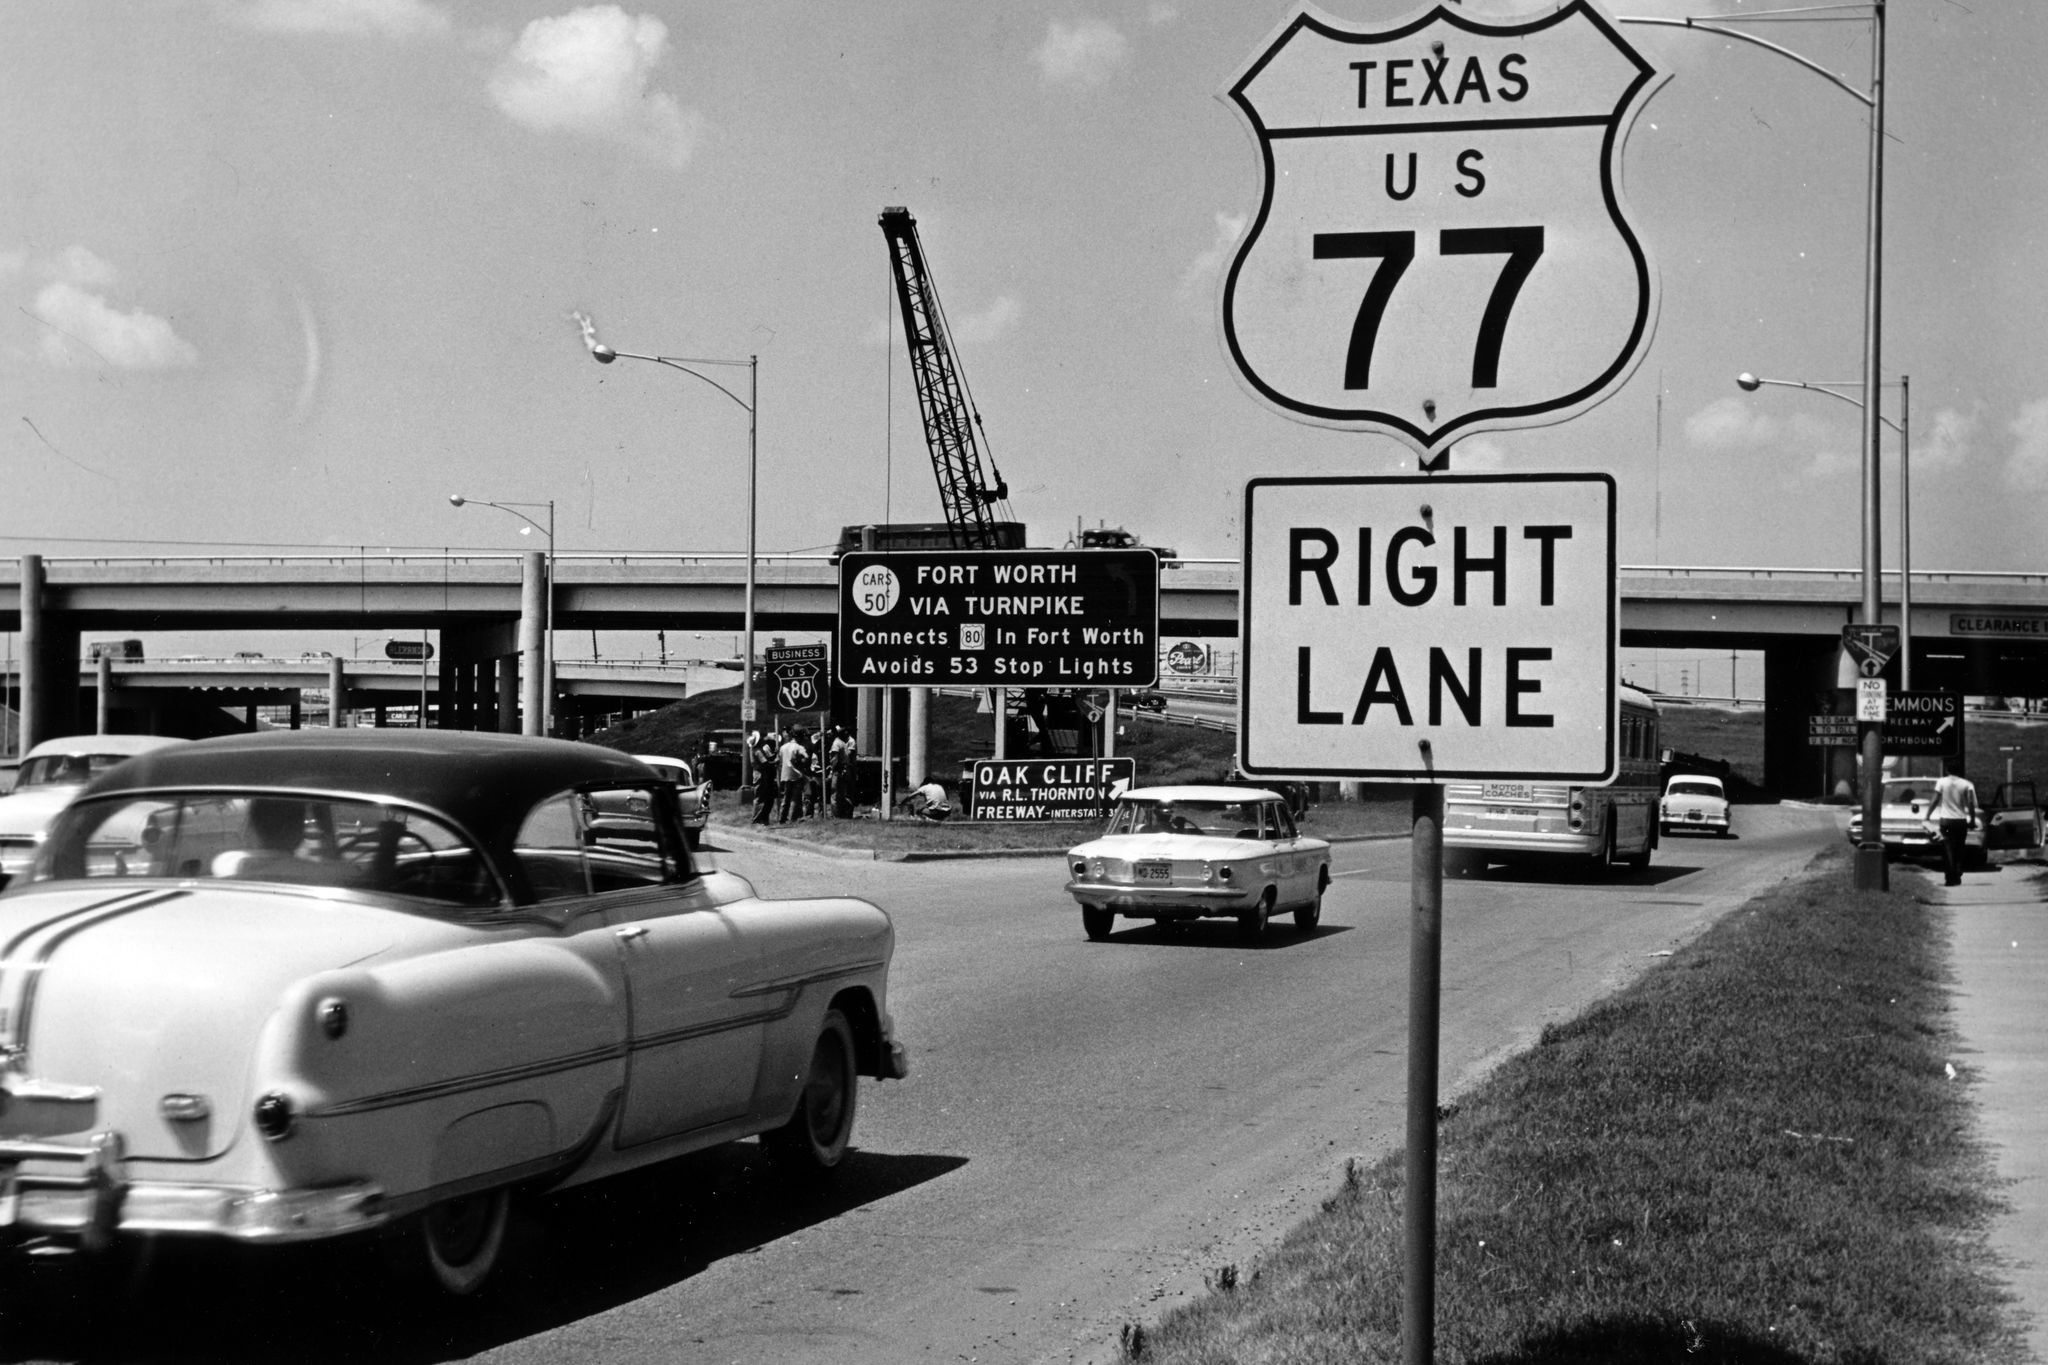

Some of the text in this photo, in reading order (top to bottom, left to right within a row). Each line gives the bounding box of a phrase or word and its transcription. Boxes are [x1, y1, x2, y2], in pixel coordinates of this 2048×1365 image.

[1349, 53, 1529, 108] TEXAS
[1313, 225, 1544, 390] 77
[917, 564, 1077, 584] FORT WORTH
[1289, 525, 1572, 607] RIGHT
[862, 573, 892, 586] CARS
[909, 596, 1084, 616] VIA TURNPIKE
[1957, 618, 2040, 633] CLEARANCE
[852, 627, 1144, 646] Connects 80 In Fort Worth
[771, 649, 820, 660] BUSINESS
[862, 656, 1133, 679] Avoids 53 Stop Lights
[791, 680, 810, 698] 80
[1298, 646, 1554, 727] LANE
[1863, 681, 1881, 690] NO
[979, 764, 1115, 785] OAK CLIFF
[979, 787, 1106, 802] VIA R.L. THORNTON
[1485, 790, 1530, 798] COACHES
